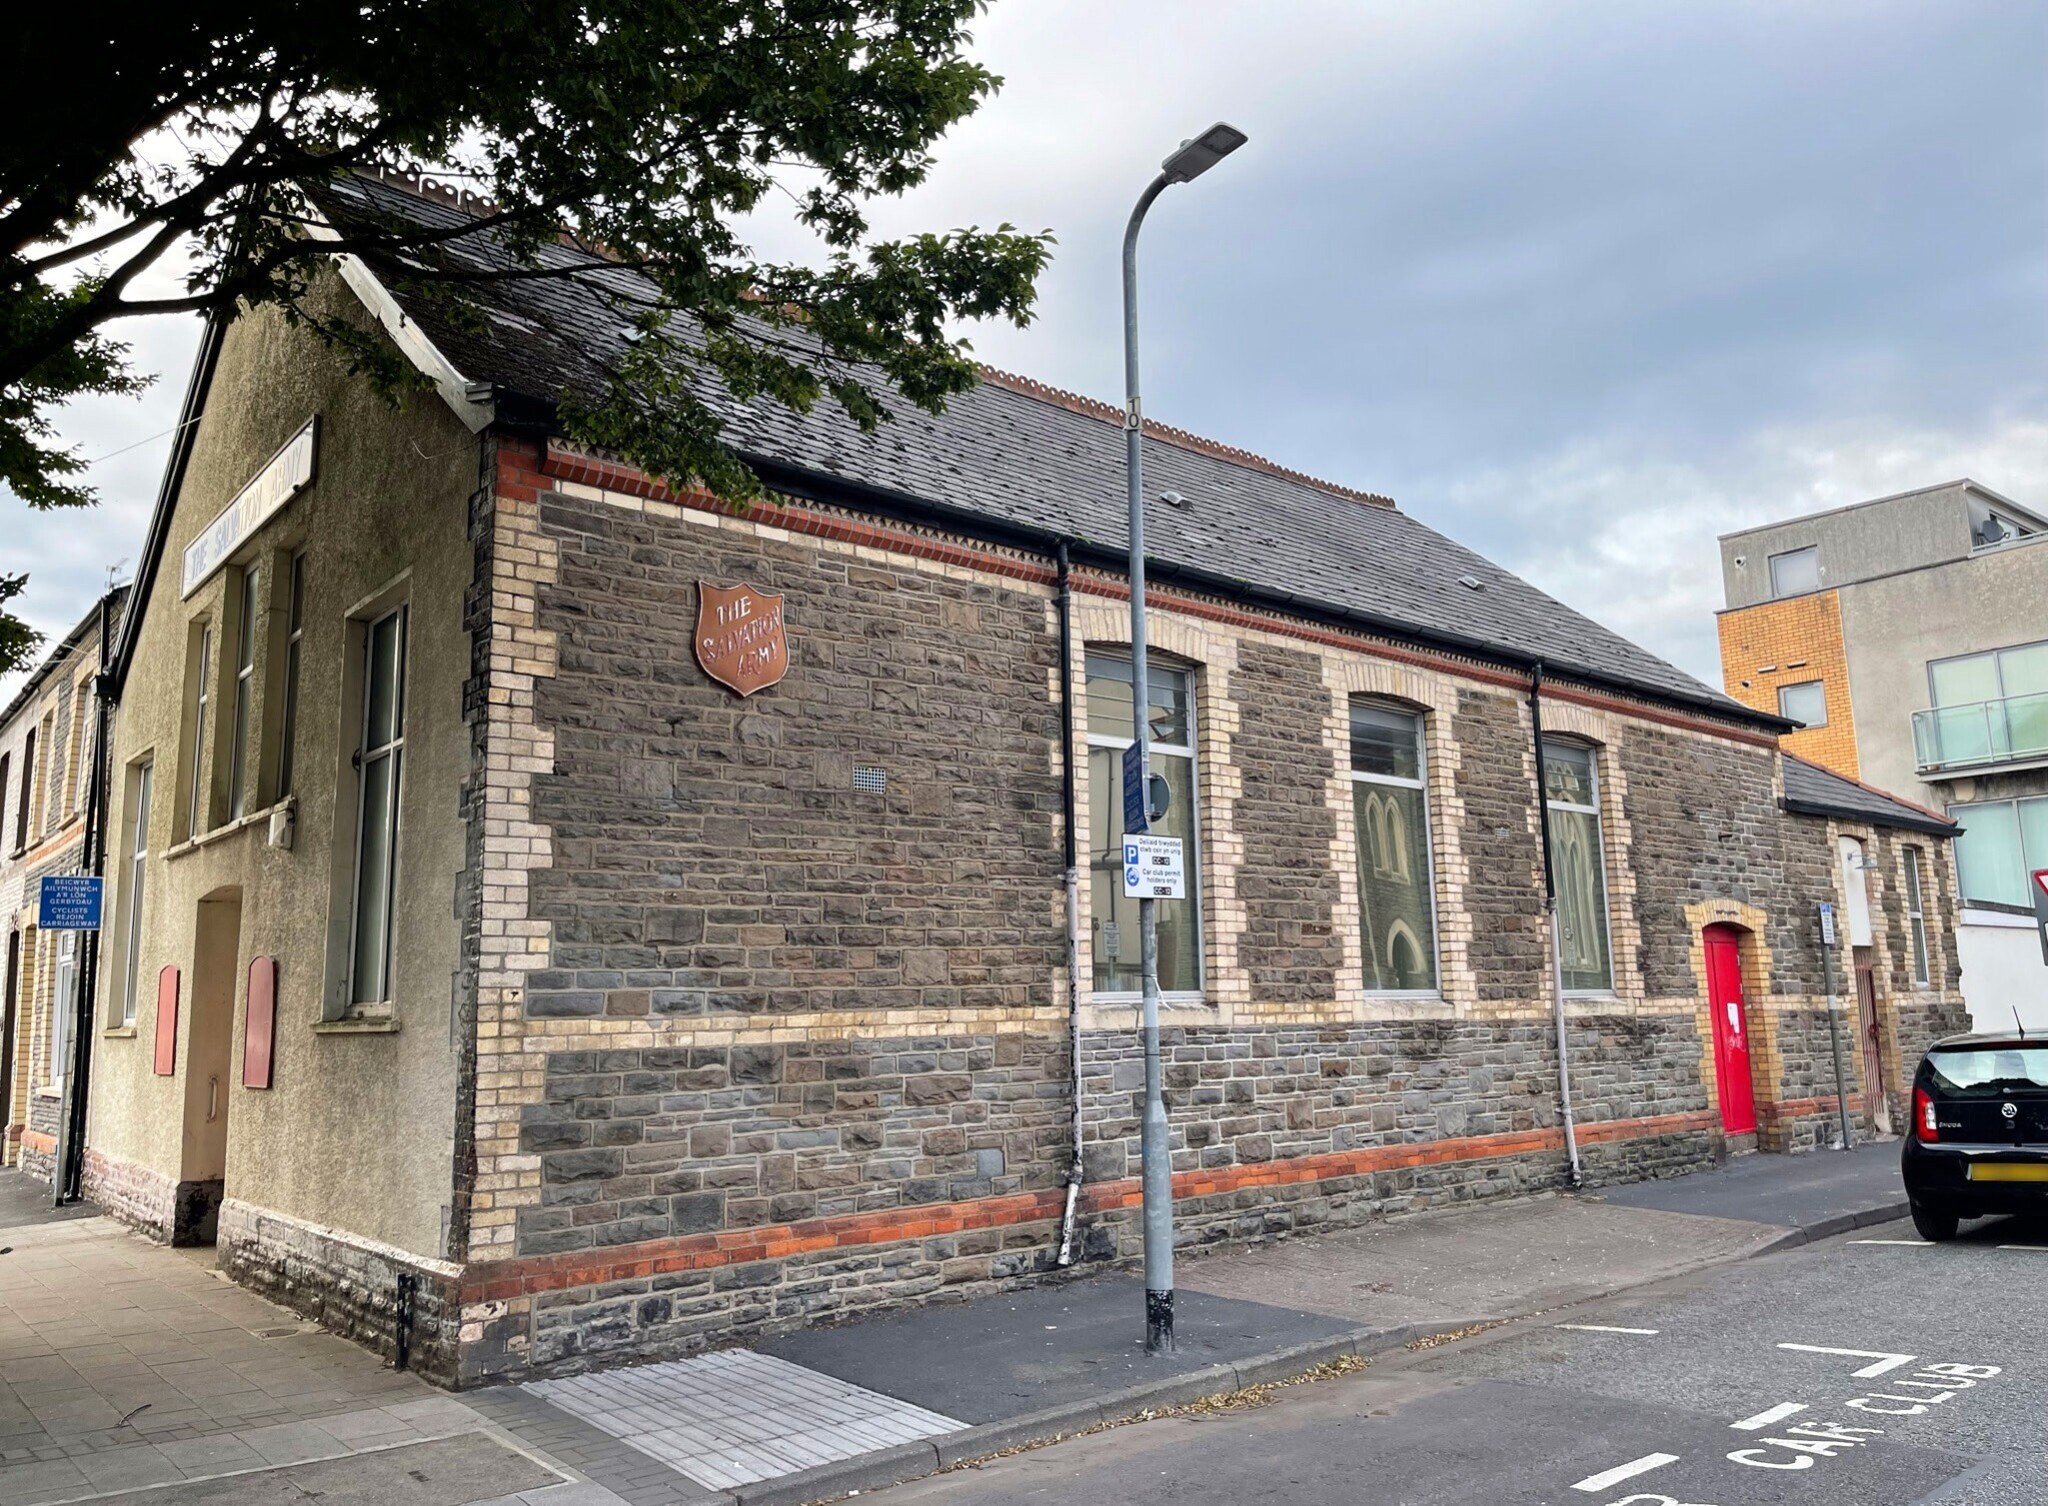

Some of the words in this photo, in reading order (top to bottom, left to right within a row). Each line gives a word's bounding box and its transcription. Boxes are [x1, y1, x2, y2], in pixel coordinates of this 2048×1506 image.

[192, 538, 208, 581] THE
[215, 483, 262, 558] SALVATION
[270, 441, 304, 507] ARMY
[702, 605, 780, 664] SALVATION
[716, 595, 752, 627] THE
[737, 637, 780, 678] ARMY
[1726, 1421, 1885, 1470] CAR
[1845, 1362, 2003, 1415] CLUB
